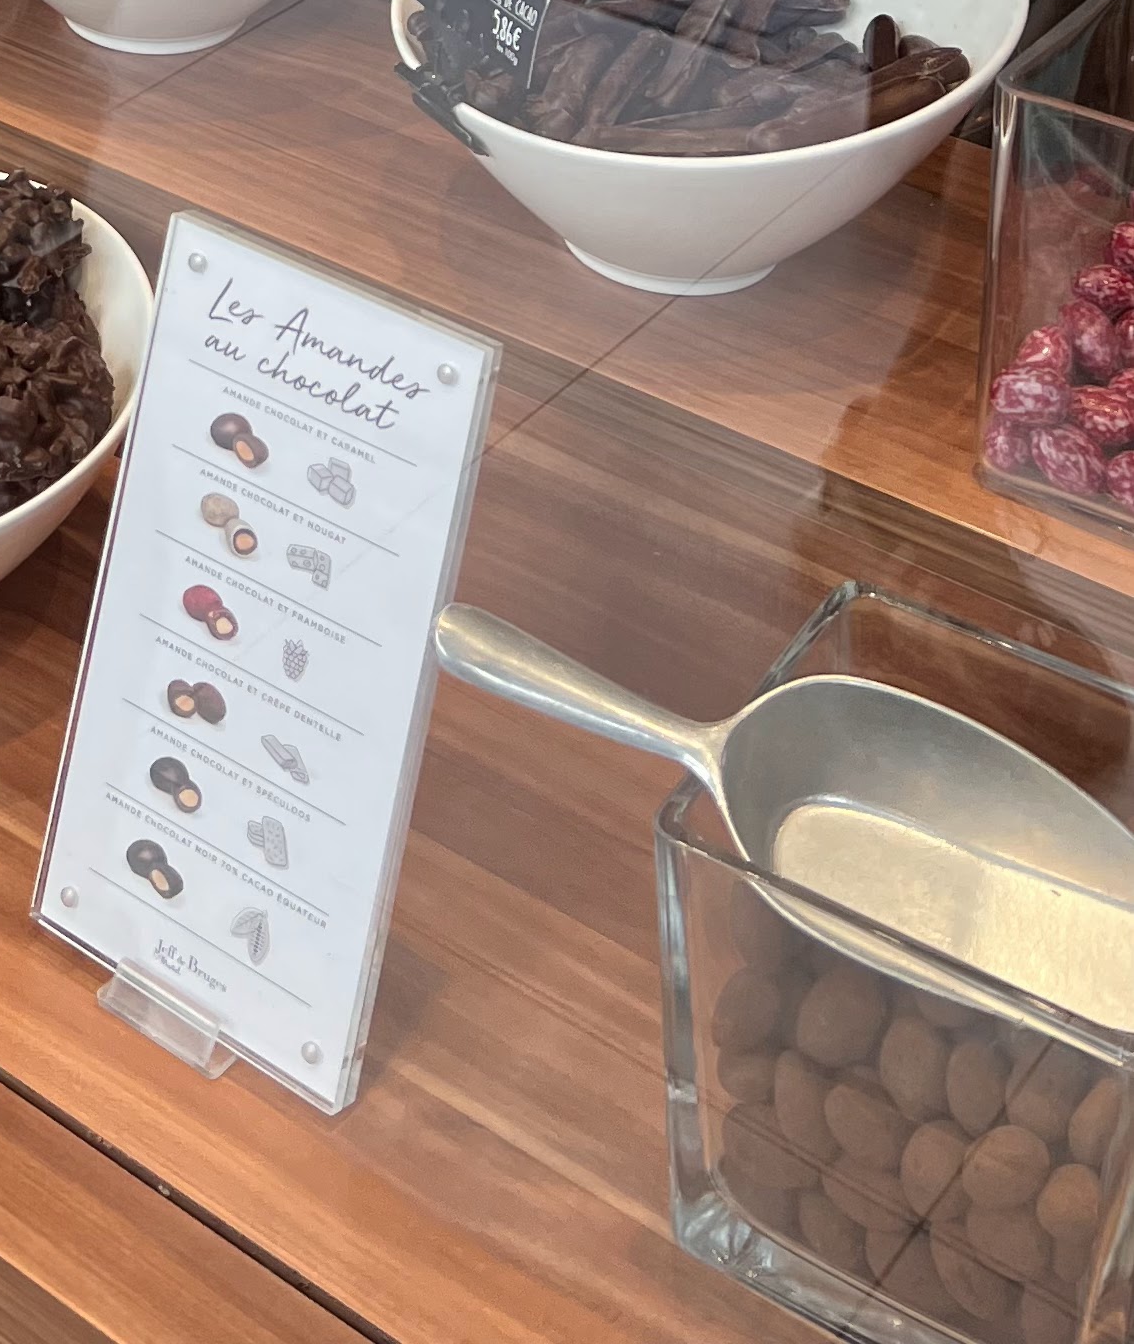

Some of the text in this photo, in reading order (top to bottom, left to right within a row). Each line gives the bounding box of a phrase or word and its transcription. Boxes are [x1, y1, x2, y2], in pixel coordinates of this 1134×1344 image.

[515, 0, 538, 26] CACAO
[204, 334, 400, 429] au chocolat
[208, 277, 431, 400] Les Amandes
[222, 385, 376, 464] AMANDE CHOCOLAT ET CARAMEL
[199, 467, 347, 545] AMANDE CHOCOLAT ET NOUGAT
[184, 555, 347, 645] AMANDE CHOCOLAT ET FRAMBOISE
[155, 634, 342, 742] AMANDE CHOCOLAT ET CRÊPE DENTELLE
[150, 725, 312, 822] AMANDE CHOCOLAT ET SPÉCULOOS
[105, 791, 328, 930] AMANDE CHOCOLAT NOIR 70% CACAO ÉQUATEUR
[153, 938, 178, 960] Jeff
[188, 954, 227, 993] Bruges
